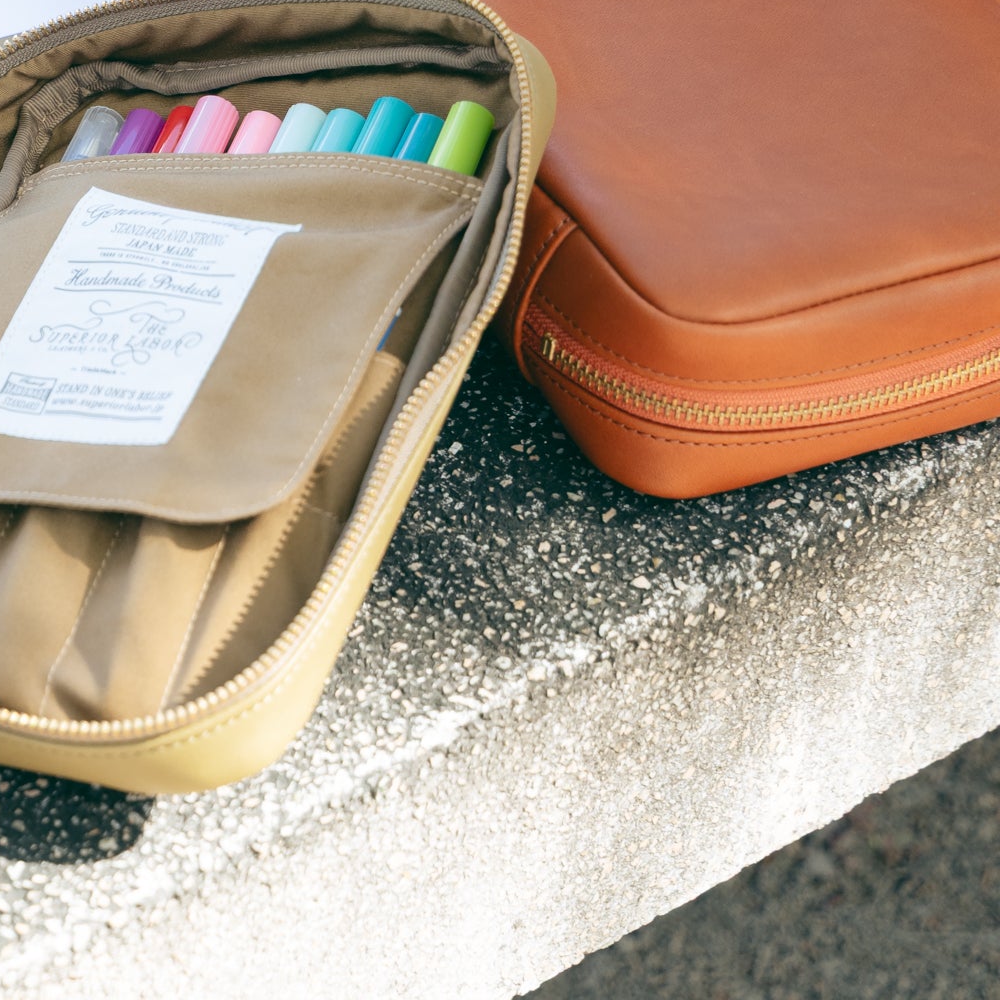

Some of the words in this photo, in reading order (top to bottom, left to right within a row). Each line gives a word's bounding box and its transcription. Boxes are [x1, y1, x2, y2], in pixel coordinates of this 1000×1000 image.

[110, 222, 166, 240] STANDARD
[164, 229, 189, 243] AND
[187, 231, 227, 247] STRONG
[126, 238, 162, 252] JAPAN
[164, 244, 198, 258] MADE
[64, 268, 146, 288] Handmade
[149, 273, 221, 298] Products
[29, 325, 120, 351] SUPERIOR
[124, 332, 203, 357] LABOR
[56, 383, 88, 395] STAND
[89, 384, 104, 396] IN
